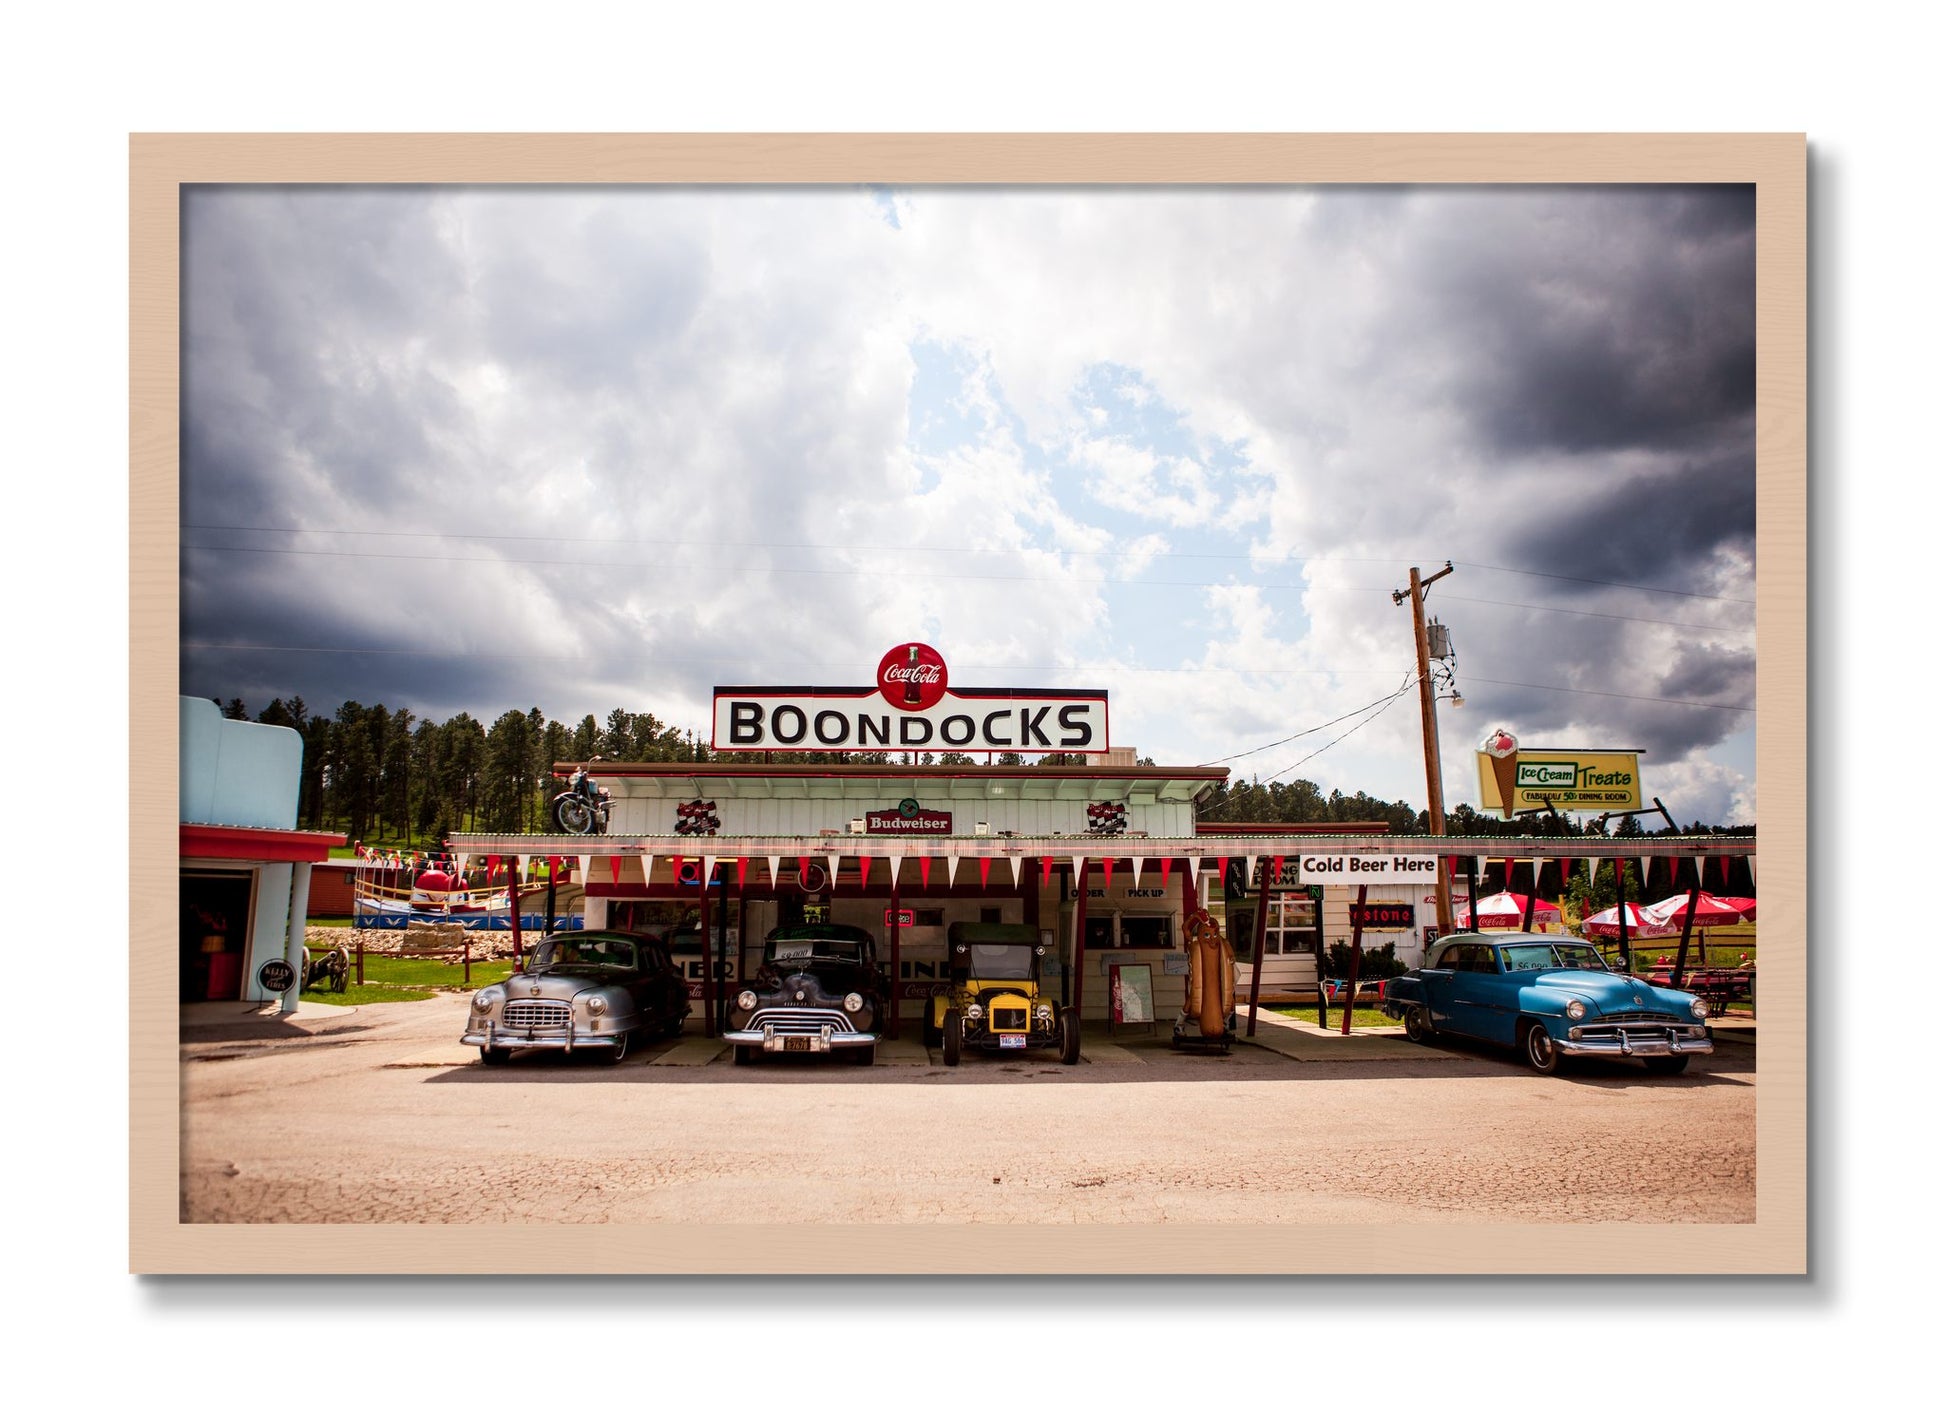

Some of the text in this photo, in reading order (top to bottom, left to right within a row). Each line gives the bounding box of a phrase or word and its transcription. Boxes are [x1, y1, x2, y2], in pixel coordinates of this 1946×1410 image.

[730, 702, 1093, 746] BOONDOCKS
[1521, 766, 1631, 788] Ice Cream Treats
[1578, 793, 1602, 801] DINING
[1605, 793, 1627, 801] ROOM
[870, 817, 948, 829] Budweiser
[1303, 857, 1435, 872] Cold Beer Here
[1071, 889, 1105, 898] ODER
[1128, 889, 1164, 898] PICK UP
